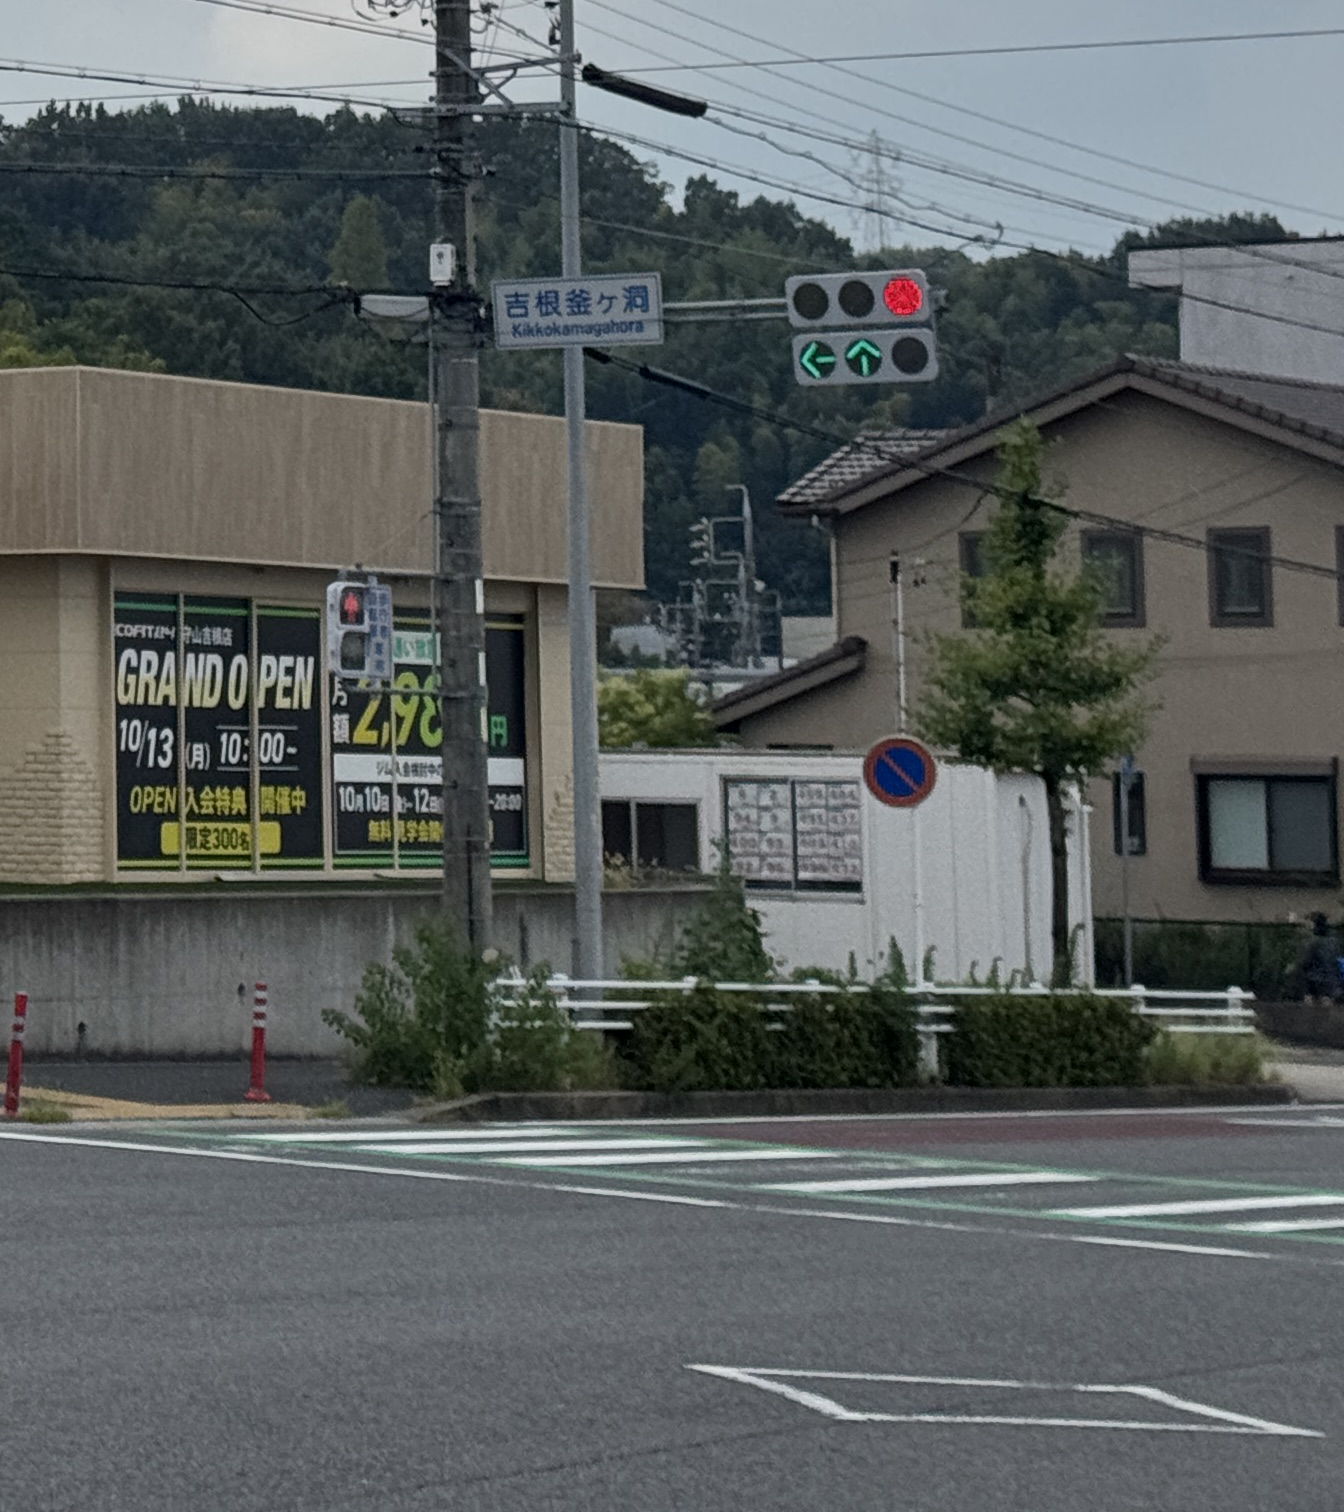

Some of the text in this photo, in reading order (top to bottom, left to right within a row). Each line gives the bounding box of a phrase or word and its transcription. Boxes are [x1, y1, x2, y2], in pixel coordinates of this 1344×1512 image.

[117, 648, 315, 711] GRAND OPEN
[120, 719, 175, 769] 10/13
